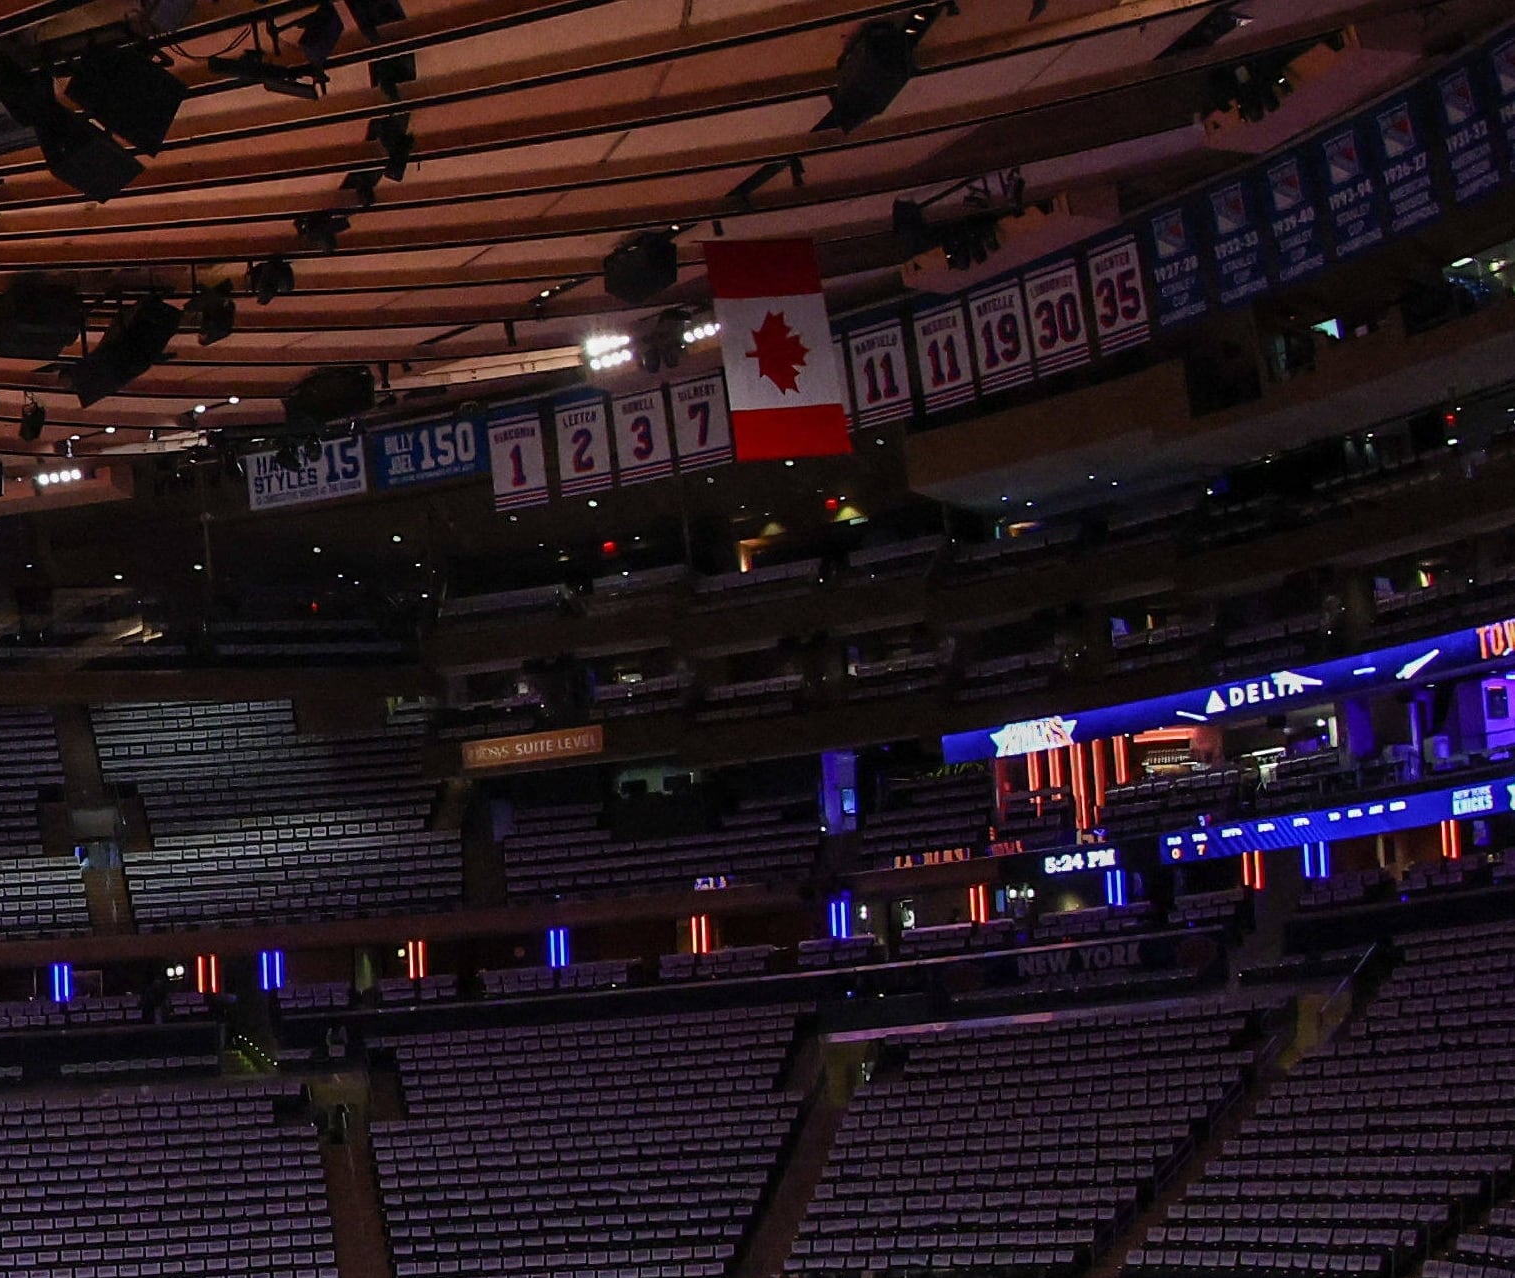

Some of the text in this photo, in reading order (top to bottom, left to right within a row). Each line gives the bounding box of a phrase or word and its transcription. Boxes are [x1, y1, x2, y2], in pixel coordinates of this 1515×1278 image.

[1096, 268, 1140, 328] 35
[982, 313, 1021, 369] 19
[1035, 292, 1080, 350] 30
[864, 352, 899, 403] 11
[928, 334, 961, 387] 11
[384, 432, 413, 456] BILLY
[630, 416, 654, 460] 3
[688, 401, 710, 446] 7
[324, 441, 360, 482] 15
[388, 453, 416, 476] JOEL
[419, 421, 476, 470] 150
[510, 444, 526, 486] 1
[572, 428, 594, 473] 2
[254, 468, 318, 494] STYLES
[1229, 677, 1305, 708] DELTA
[514, 739, 553, 755] SUITE
[557, 734, 596, 750] LEVEL
[1452, 795, 1493, 816] KNICKS
[1044, 848, 1116, 874] 5:24 PM
